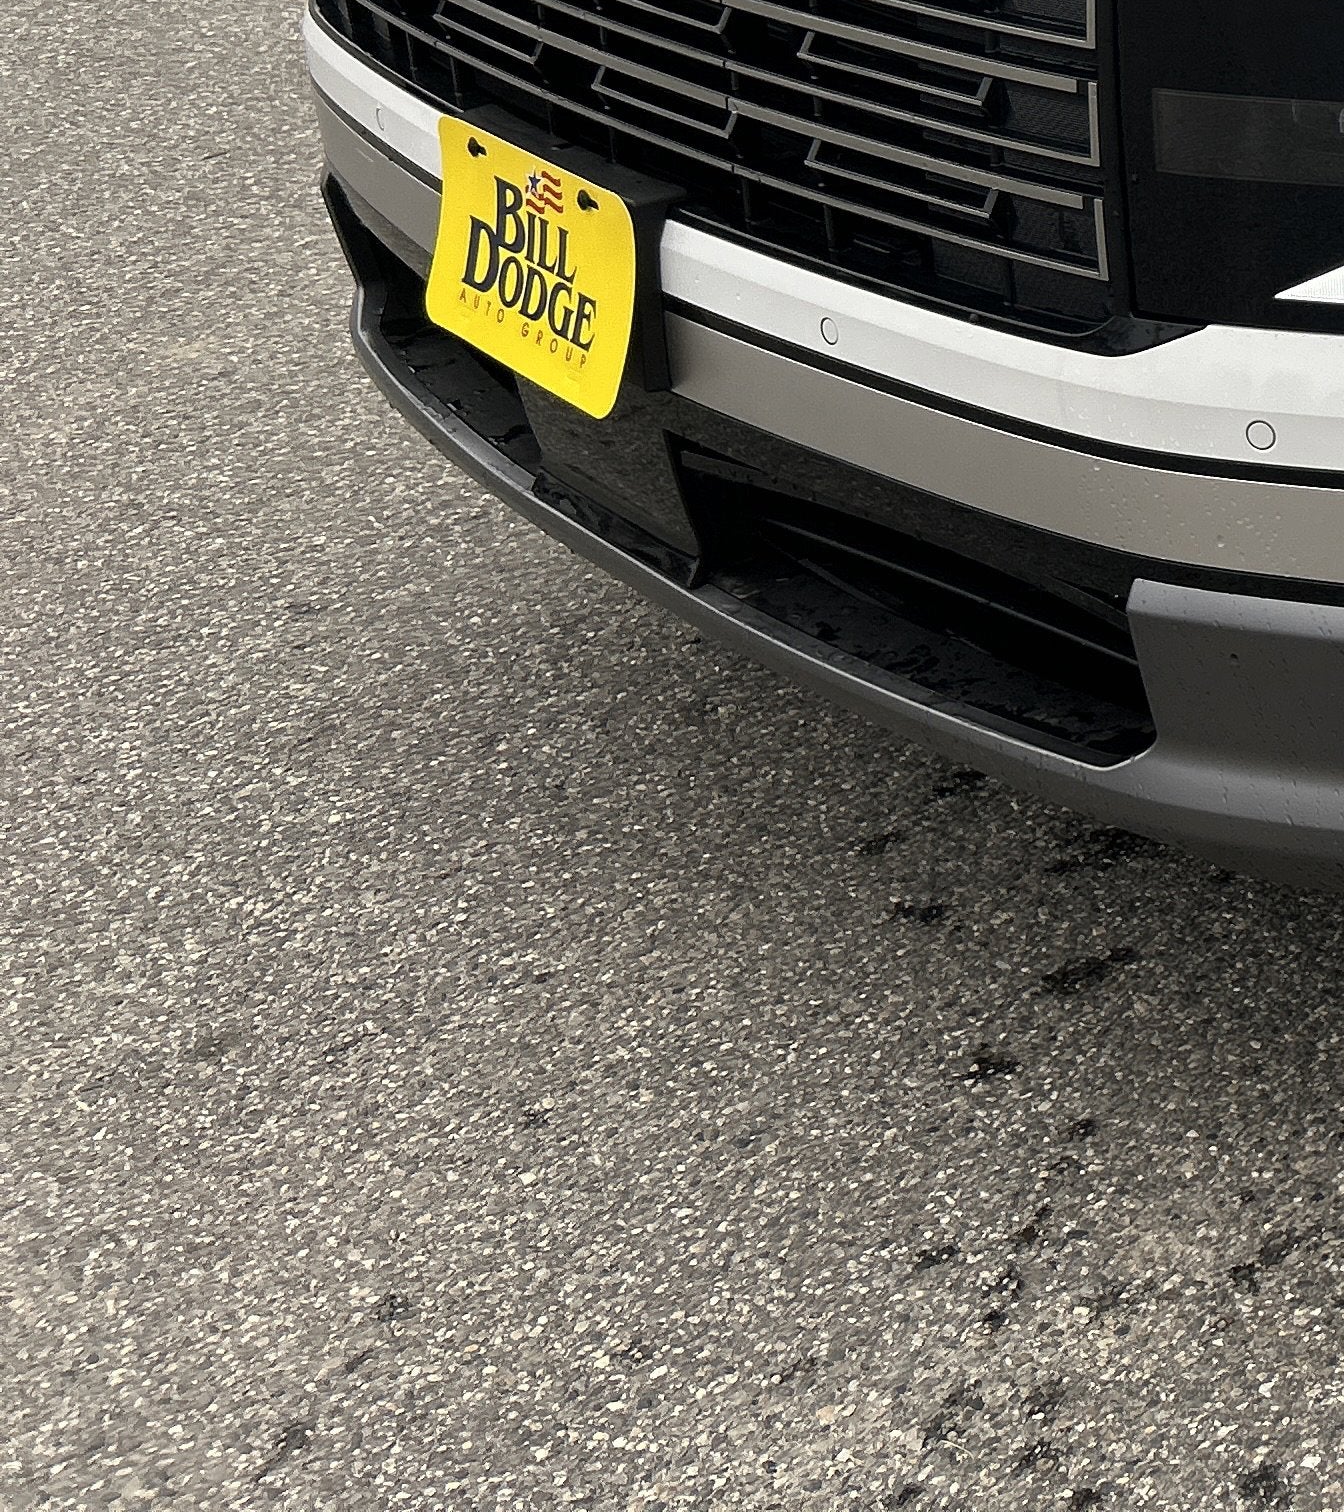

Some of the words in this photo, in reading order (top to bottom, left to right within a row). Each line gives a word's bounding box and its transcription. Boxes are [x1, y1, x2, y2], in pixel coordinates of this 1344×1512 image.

[461, 215, 597, 352] DODGE
[493, 175, 578, 284] BILL
[459, 290, 505, 324] AUTO
[521, 322, 587, 367] GROUP
